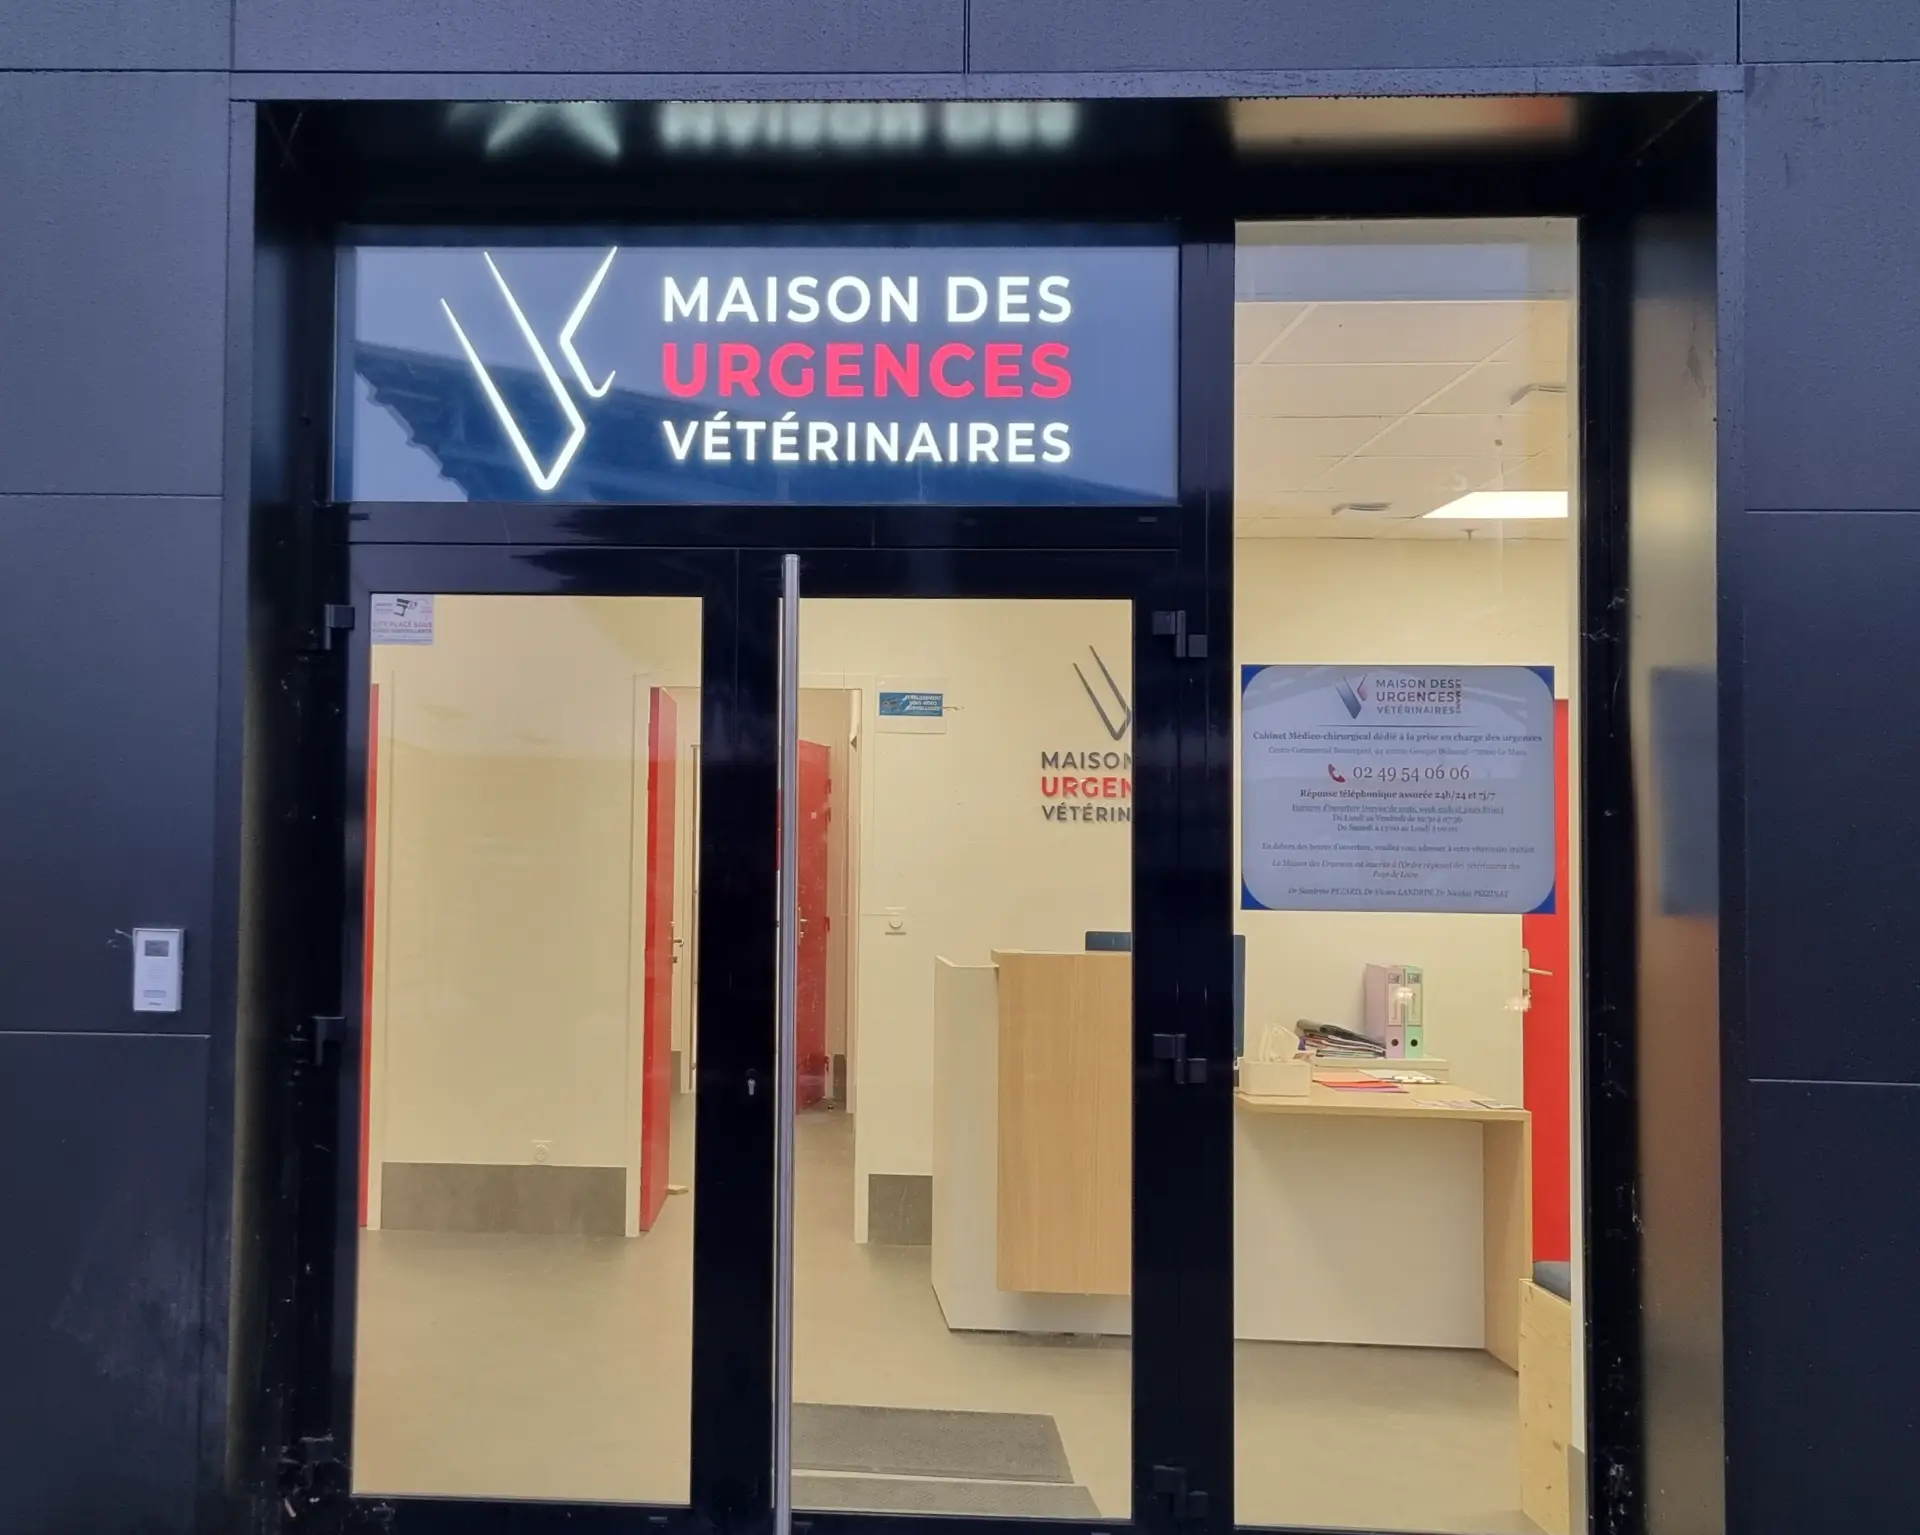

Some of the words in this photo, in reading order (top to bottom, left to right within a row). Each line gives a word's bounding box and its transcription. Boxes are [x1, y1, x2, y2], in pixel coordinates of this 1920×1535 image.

[663, 275, 919, 323] MAISON
[947, 275, 1072, 323] DES
[662, 342, 1072, 399] URGENCES
[663, 411, 1072, 463] VÉTÉRINAIRES
[1376, 679, 1426, 689] MAISON
[1430, 679, 1456, 689] DES
[1376, 691, 1455, 703] URGENCES
[1377, 703, 1455, 715] VÉTÉRINAIRES
[1253, 731, 1287, 740] Cabinet
[1289, 731, 1371, 742] Médico-chirurgical
[1406, 732, 1415, 741] la
[1416, 732, 1440, 743] prise
[1453, 732, 1484, 743] charge
[1485, 733, 1500, 741] des
[1502, 733, 1543, 744] urgences
[1353, 766, 1373, 779] 02
[1377, 766, 1397, 782] 49
[1401, 767, 1420, 783] 54
[1424, 765, 1445, 780] 06
[1449, 765, 1470, 780] 06
[1300, 789, 1338, 800] Réponse
[1340, 788, 1397, 801] téléphonique
[1399, 790, 1433, 799] assurée
[1435, 790, 1466, 800] 24h/24
[1468, 791, 1477, 799] et
